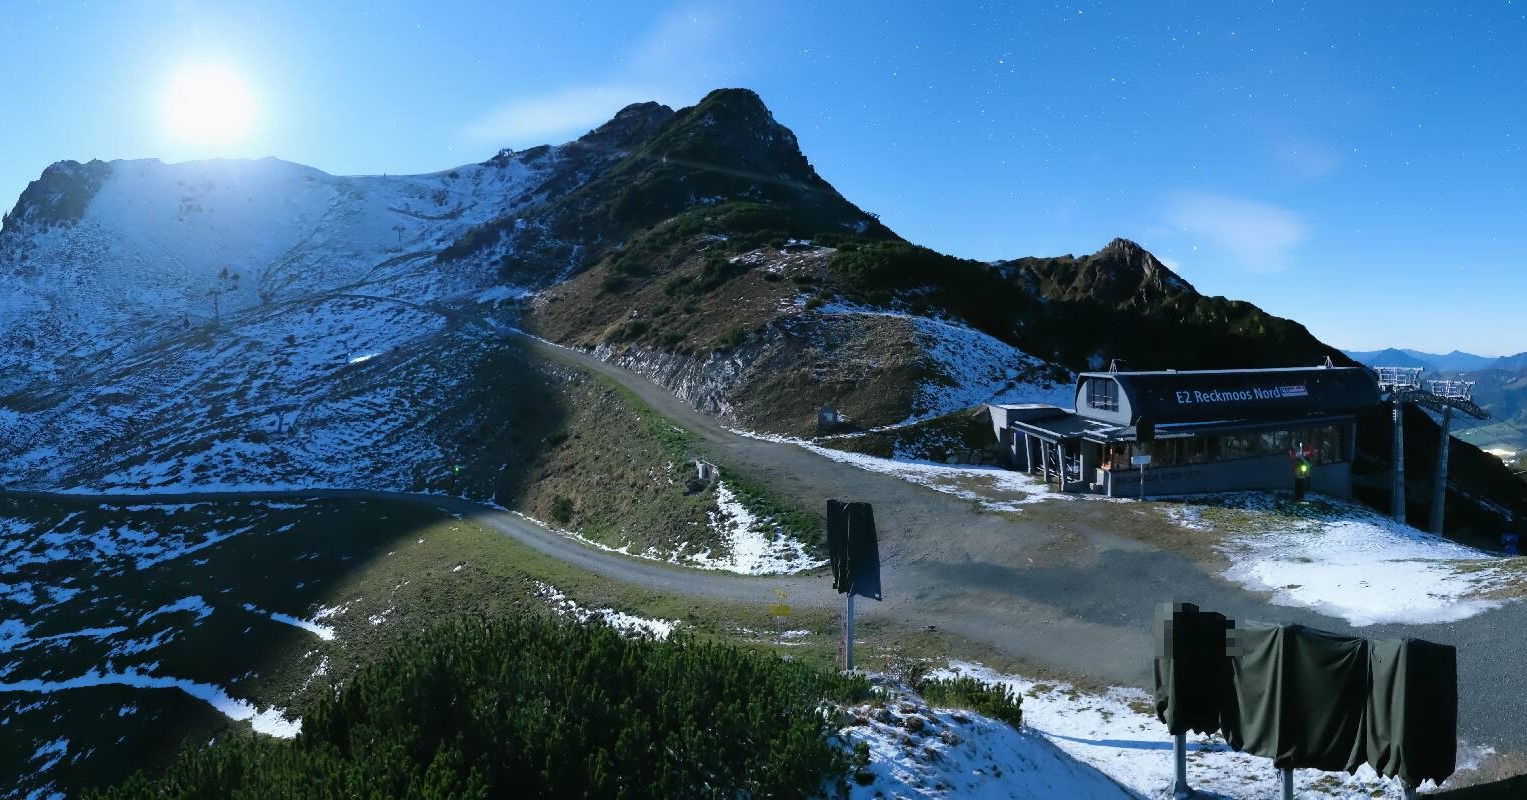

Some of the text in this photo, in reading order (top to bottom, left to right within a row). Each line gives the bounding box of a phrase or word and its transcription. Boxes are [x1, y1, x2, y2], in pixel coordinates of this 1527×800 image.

[1176, 391, 1192, 404] E2
[1194, 389, 1252, 402] Reckmoos
[1254, 386, 1281, 400] Nord
